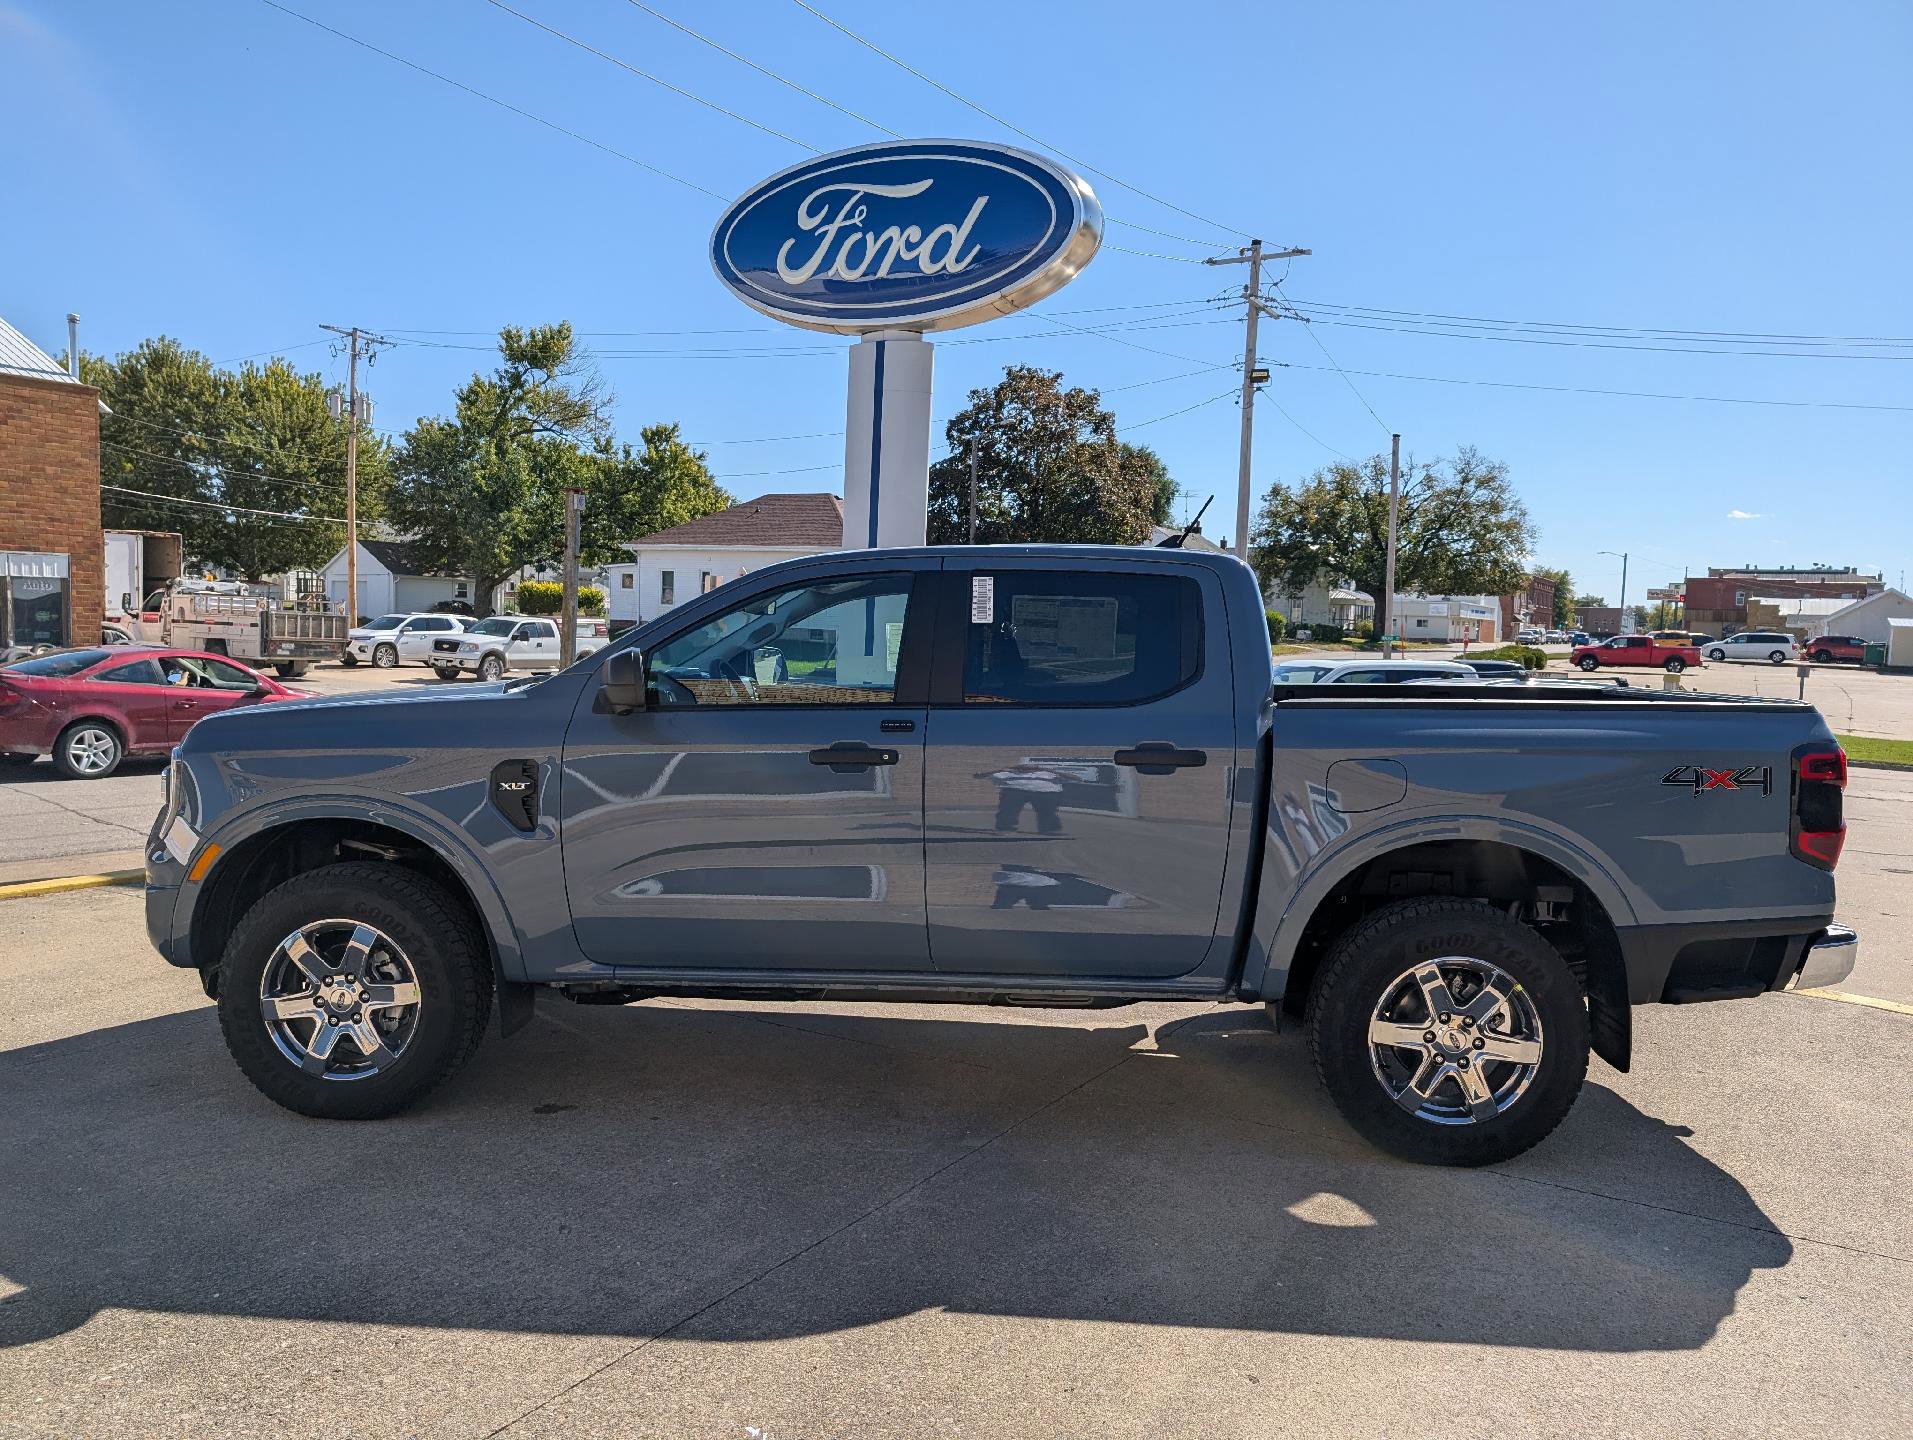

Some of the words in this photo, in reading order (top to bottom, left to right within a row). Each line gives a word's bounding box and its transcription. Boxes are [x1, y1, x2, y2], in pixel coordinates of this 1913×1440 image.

[776, 178, 990, 285] Ford
[499, 782, 531, 791] XLT
[1415, 933, 1549, 982] GOODYEAR
